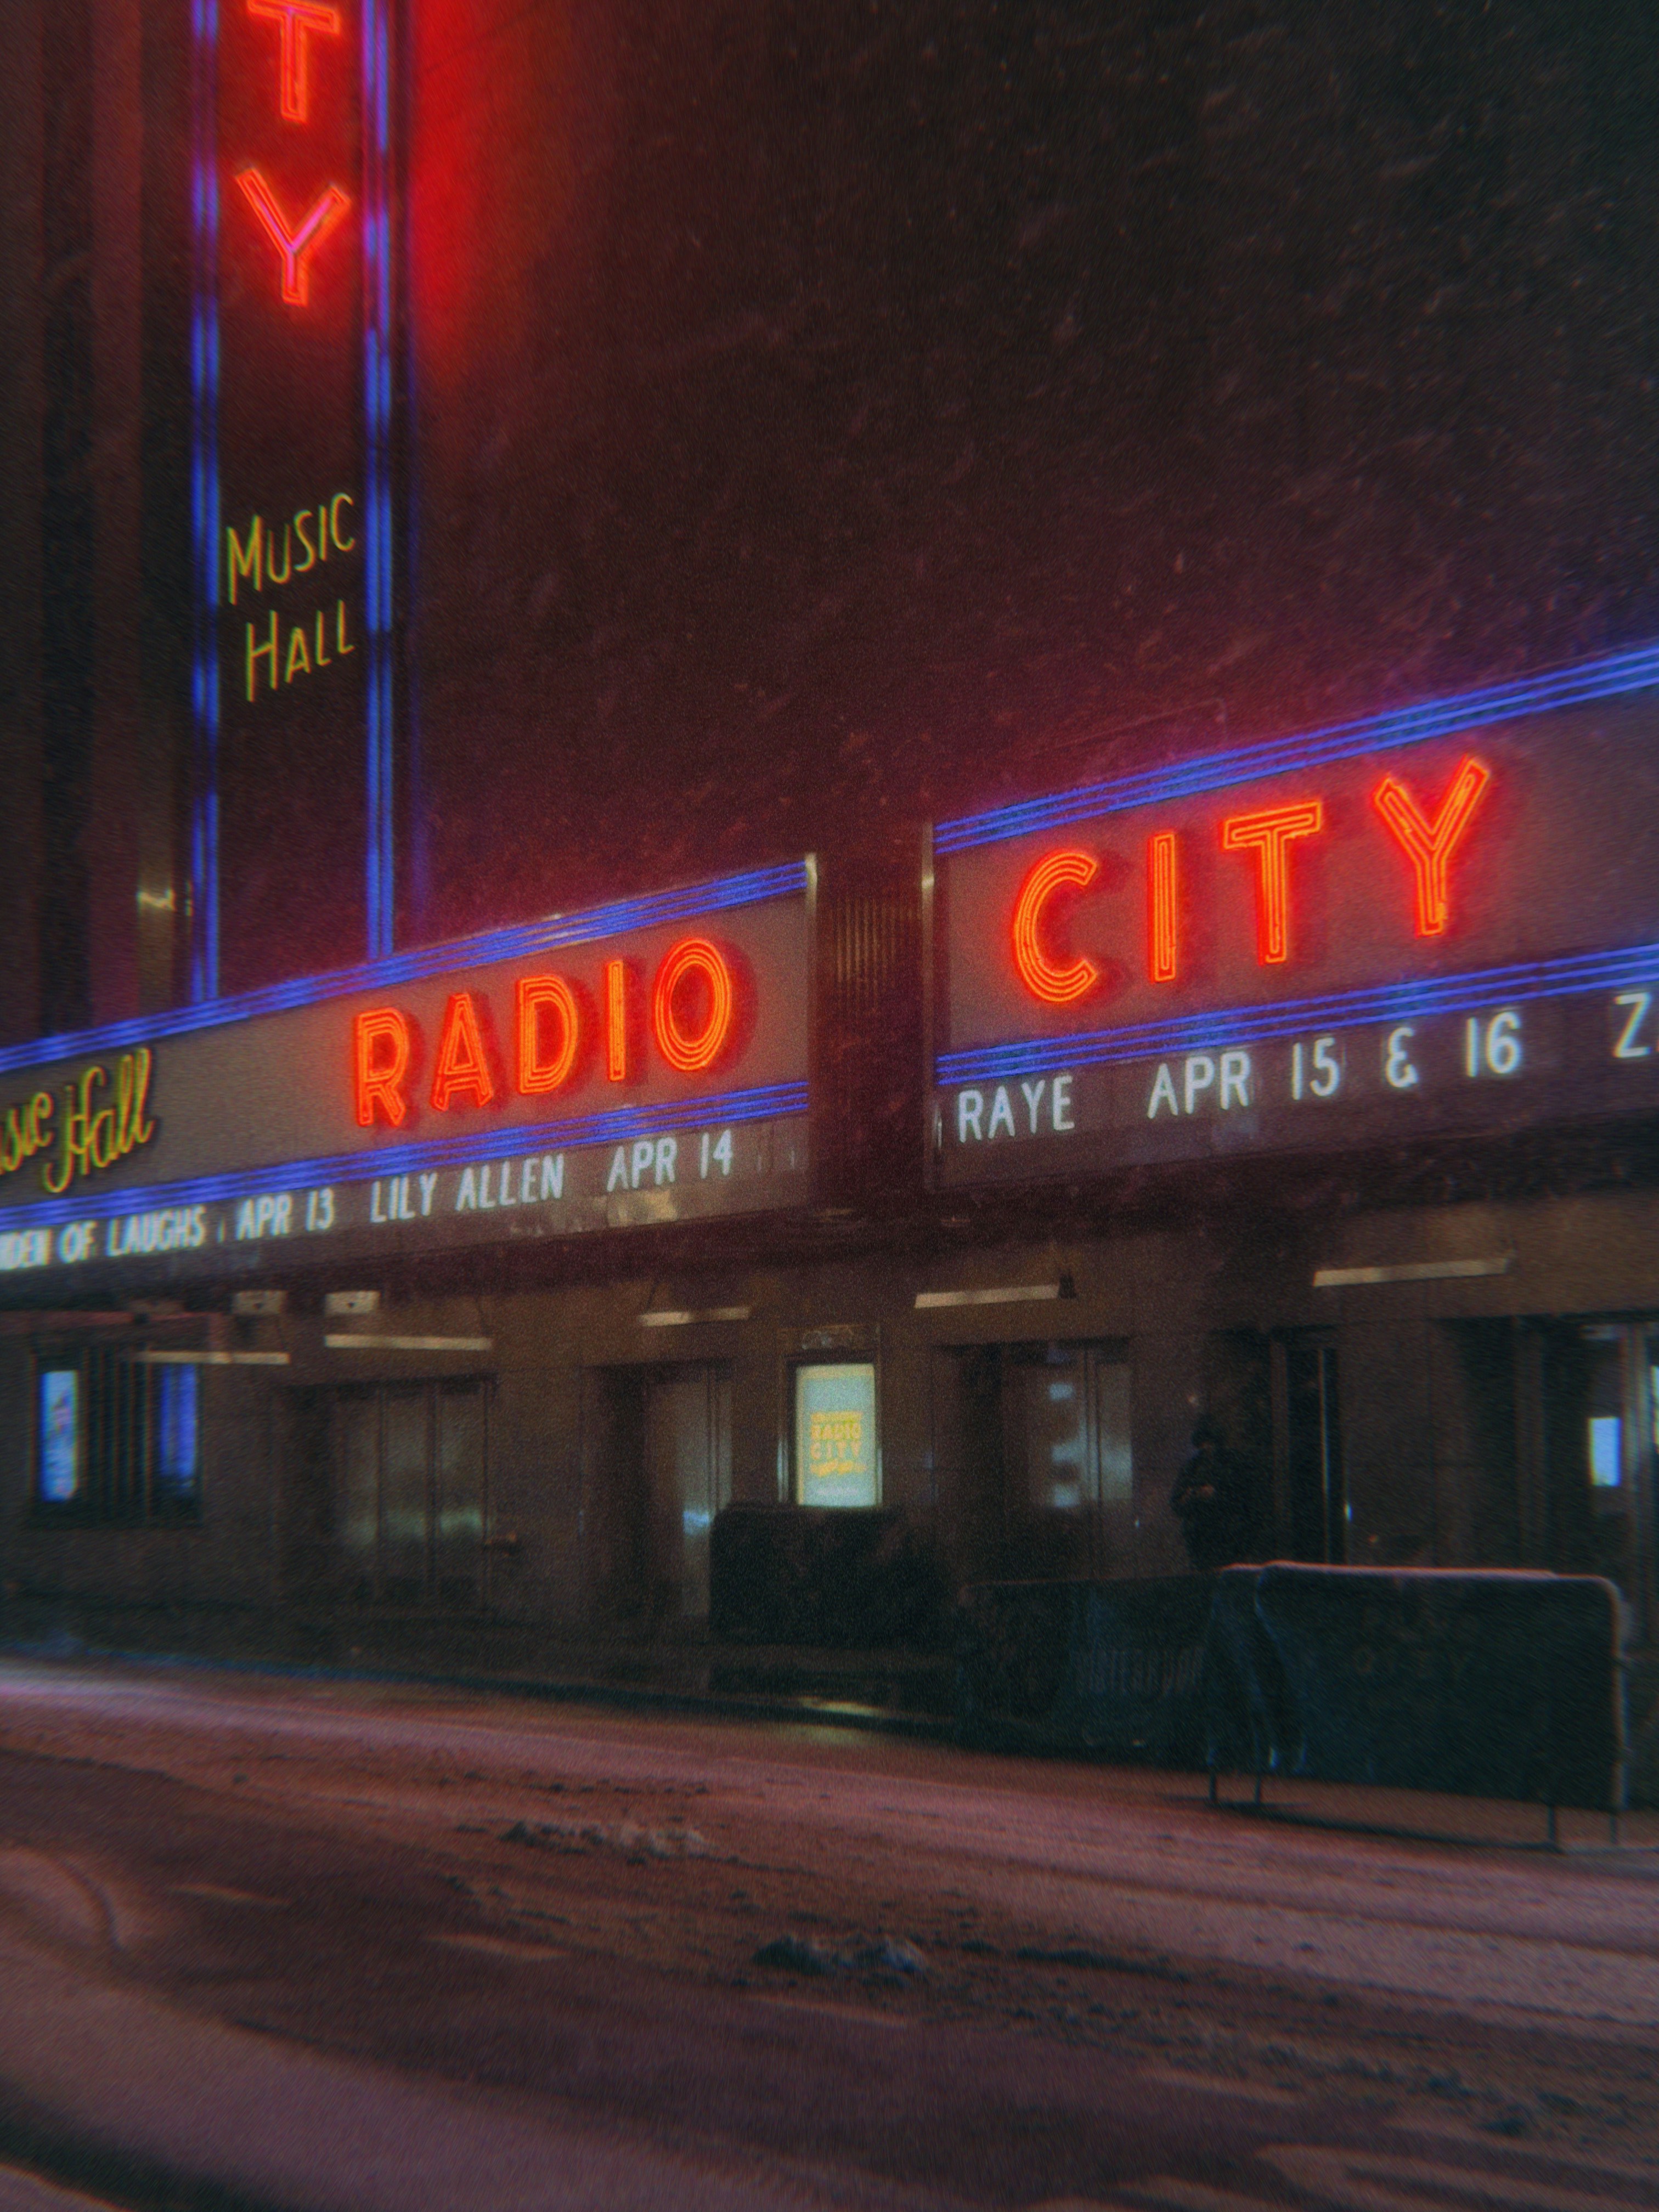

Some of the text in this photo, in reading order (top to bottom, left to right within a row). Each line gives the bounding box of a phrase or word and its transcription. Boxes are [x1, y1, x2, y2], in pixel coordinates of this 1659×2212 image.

[226, 492, 356, 605] MUSIC
[245, 599, 356, 703] HALL
[1013, 754, 1491, 1003] CITY
[353, 936, 734, 1128] RADIO
[957, 991, 1659, 1143] RAYE APR 15 & 16 Z
[0, 1048, 156, 1193] sic Hall
[58, 1220, 99, 1263] OF
[105, 1205, 207, 1258] LAUGHS
[235, 1193, 292, 1241] APR
[304, 1187, 335, 1232] 13
[369, 1172, 438, 1223] LILY
[456, 1153, 565, 1211] ALLEN
[606, 1136, 678, 1193] APR
[699, 1128, 733, 1180] 14
